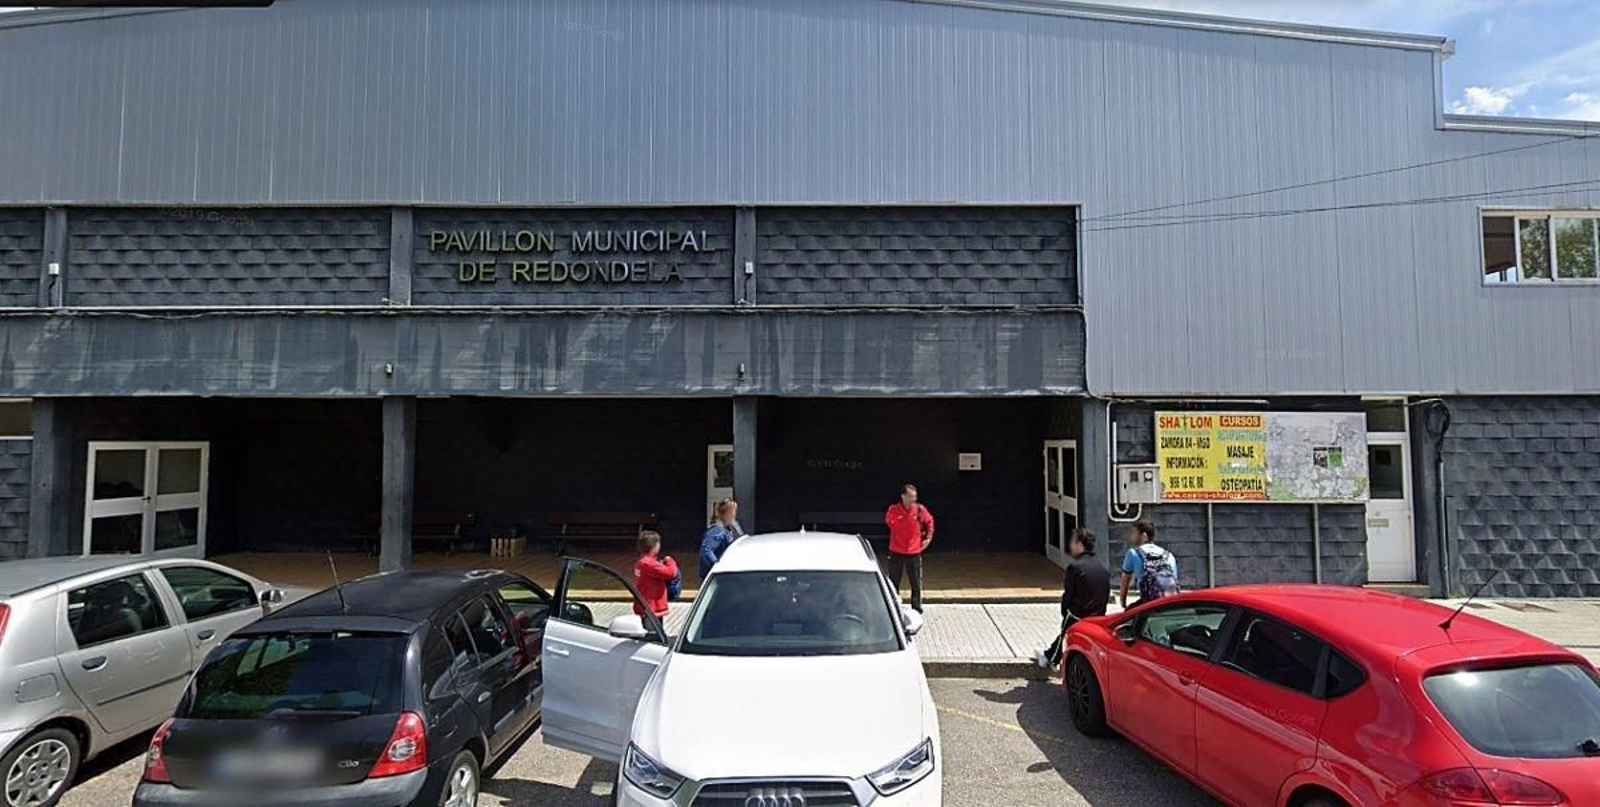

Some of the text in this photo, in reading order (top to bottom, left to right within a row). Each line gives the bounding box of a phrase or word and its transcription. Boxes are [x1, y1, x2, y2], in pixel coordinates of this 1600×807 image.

[430, 229, 716, 252] PAVILLON MUNICIPAL
[458, 261, 684, 283] DE REDONDELA
[1221, 416, 1259, 426] CURSOS
[1161, 437, 1184, 449] ZAMORA
[1197, 437, 1210, 449] VIGO
[1227, 446, 1254, 458] MASAJE
